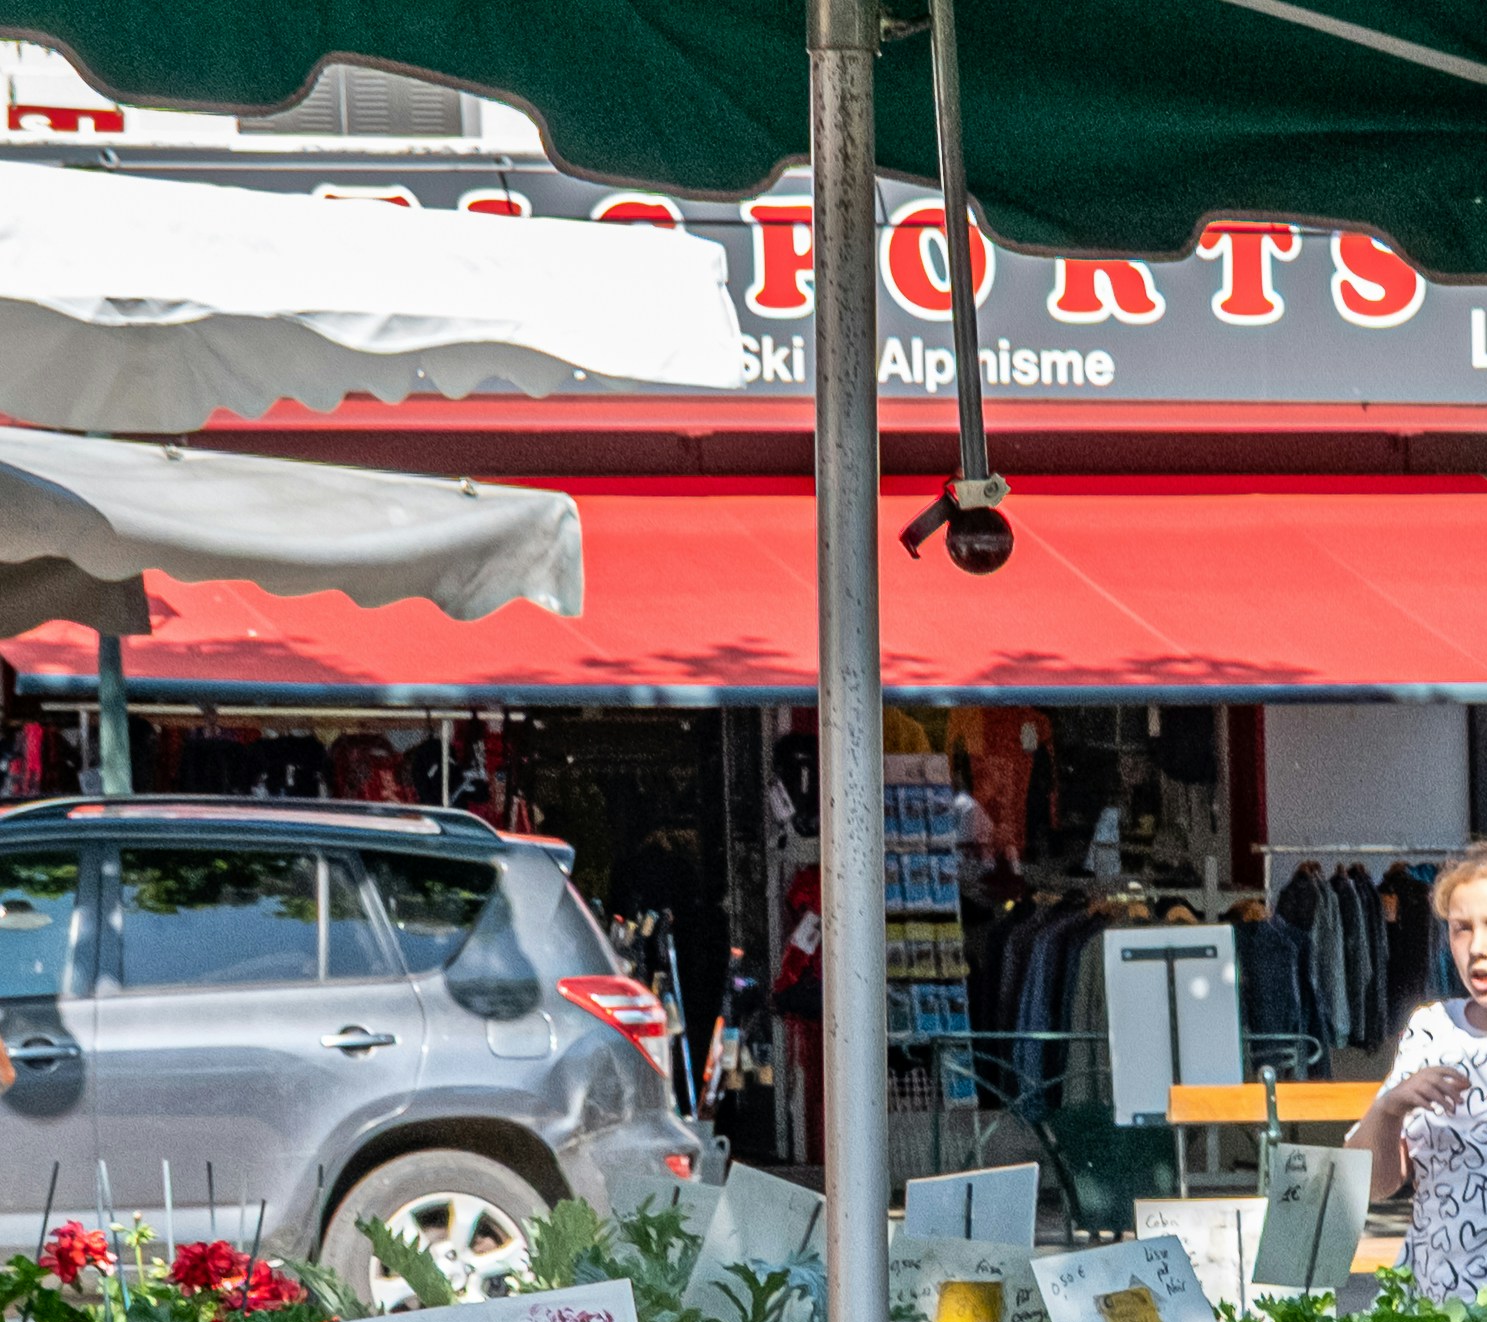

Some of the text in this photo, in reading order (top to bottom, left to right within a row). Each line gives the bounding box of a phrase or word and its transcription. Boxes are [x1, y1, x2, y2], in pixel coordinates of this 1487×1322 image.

[590, 193, 1427, 329] PORTS
[741, 335, 1117, 393] Ski Alpnisme
